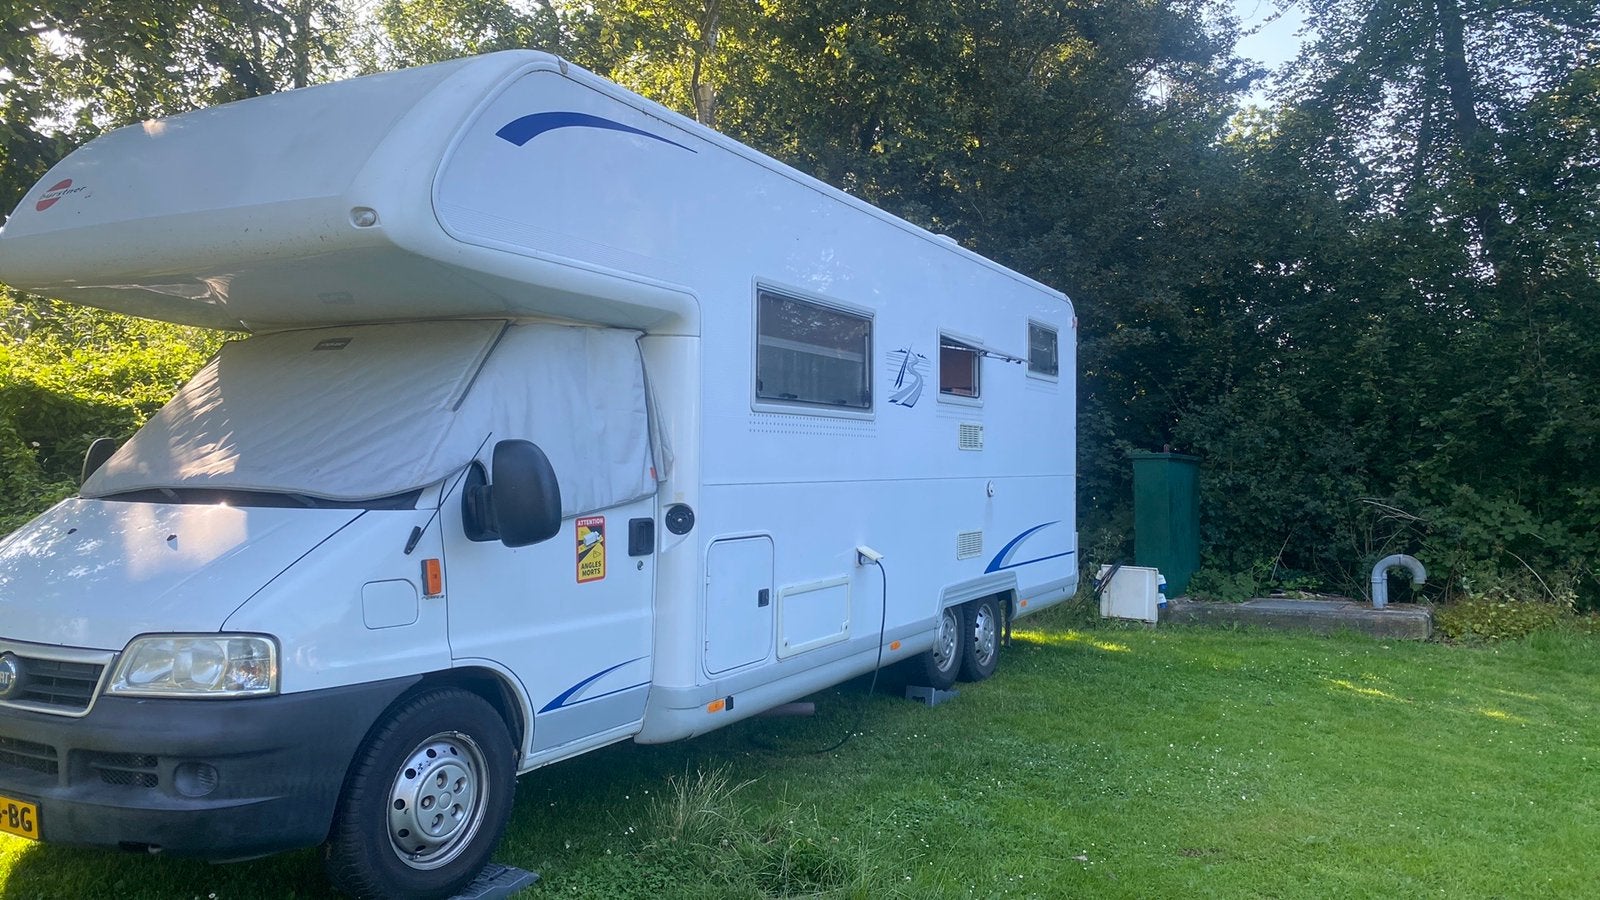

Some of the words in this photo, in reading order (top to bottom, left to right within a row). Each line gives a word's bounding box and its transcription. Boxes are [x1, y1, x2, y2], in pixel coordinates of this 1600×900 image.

[577, 517, 604, 526] ATTENTION
[581, 560, 602, 570] ANGLES
[581, 568, 601, 577] MORTS
